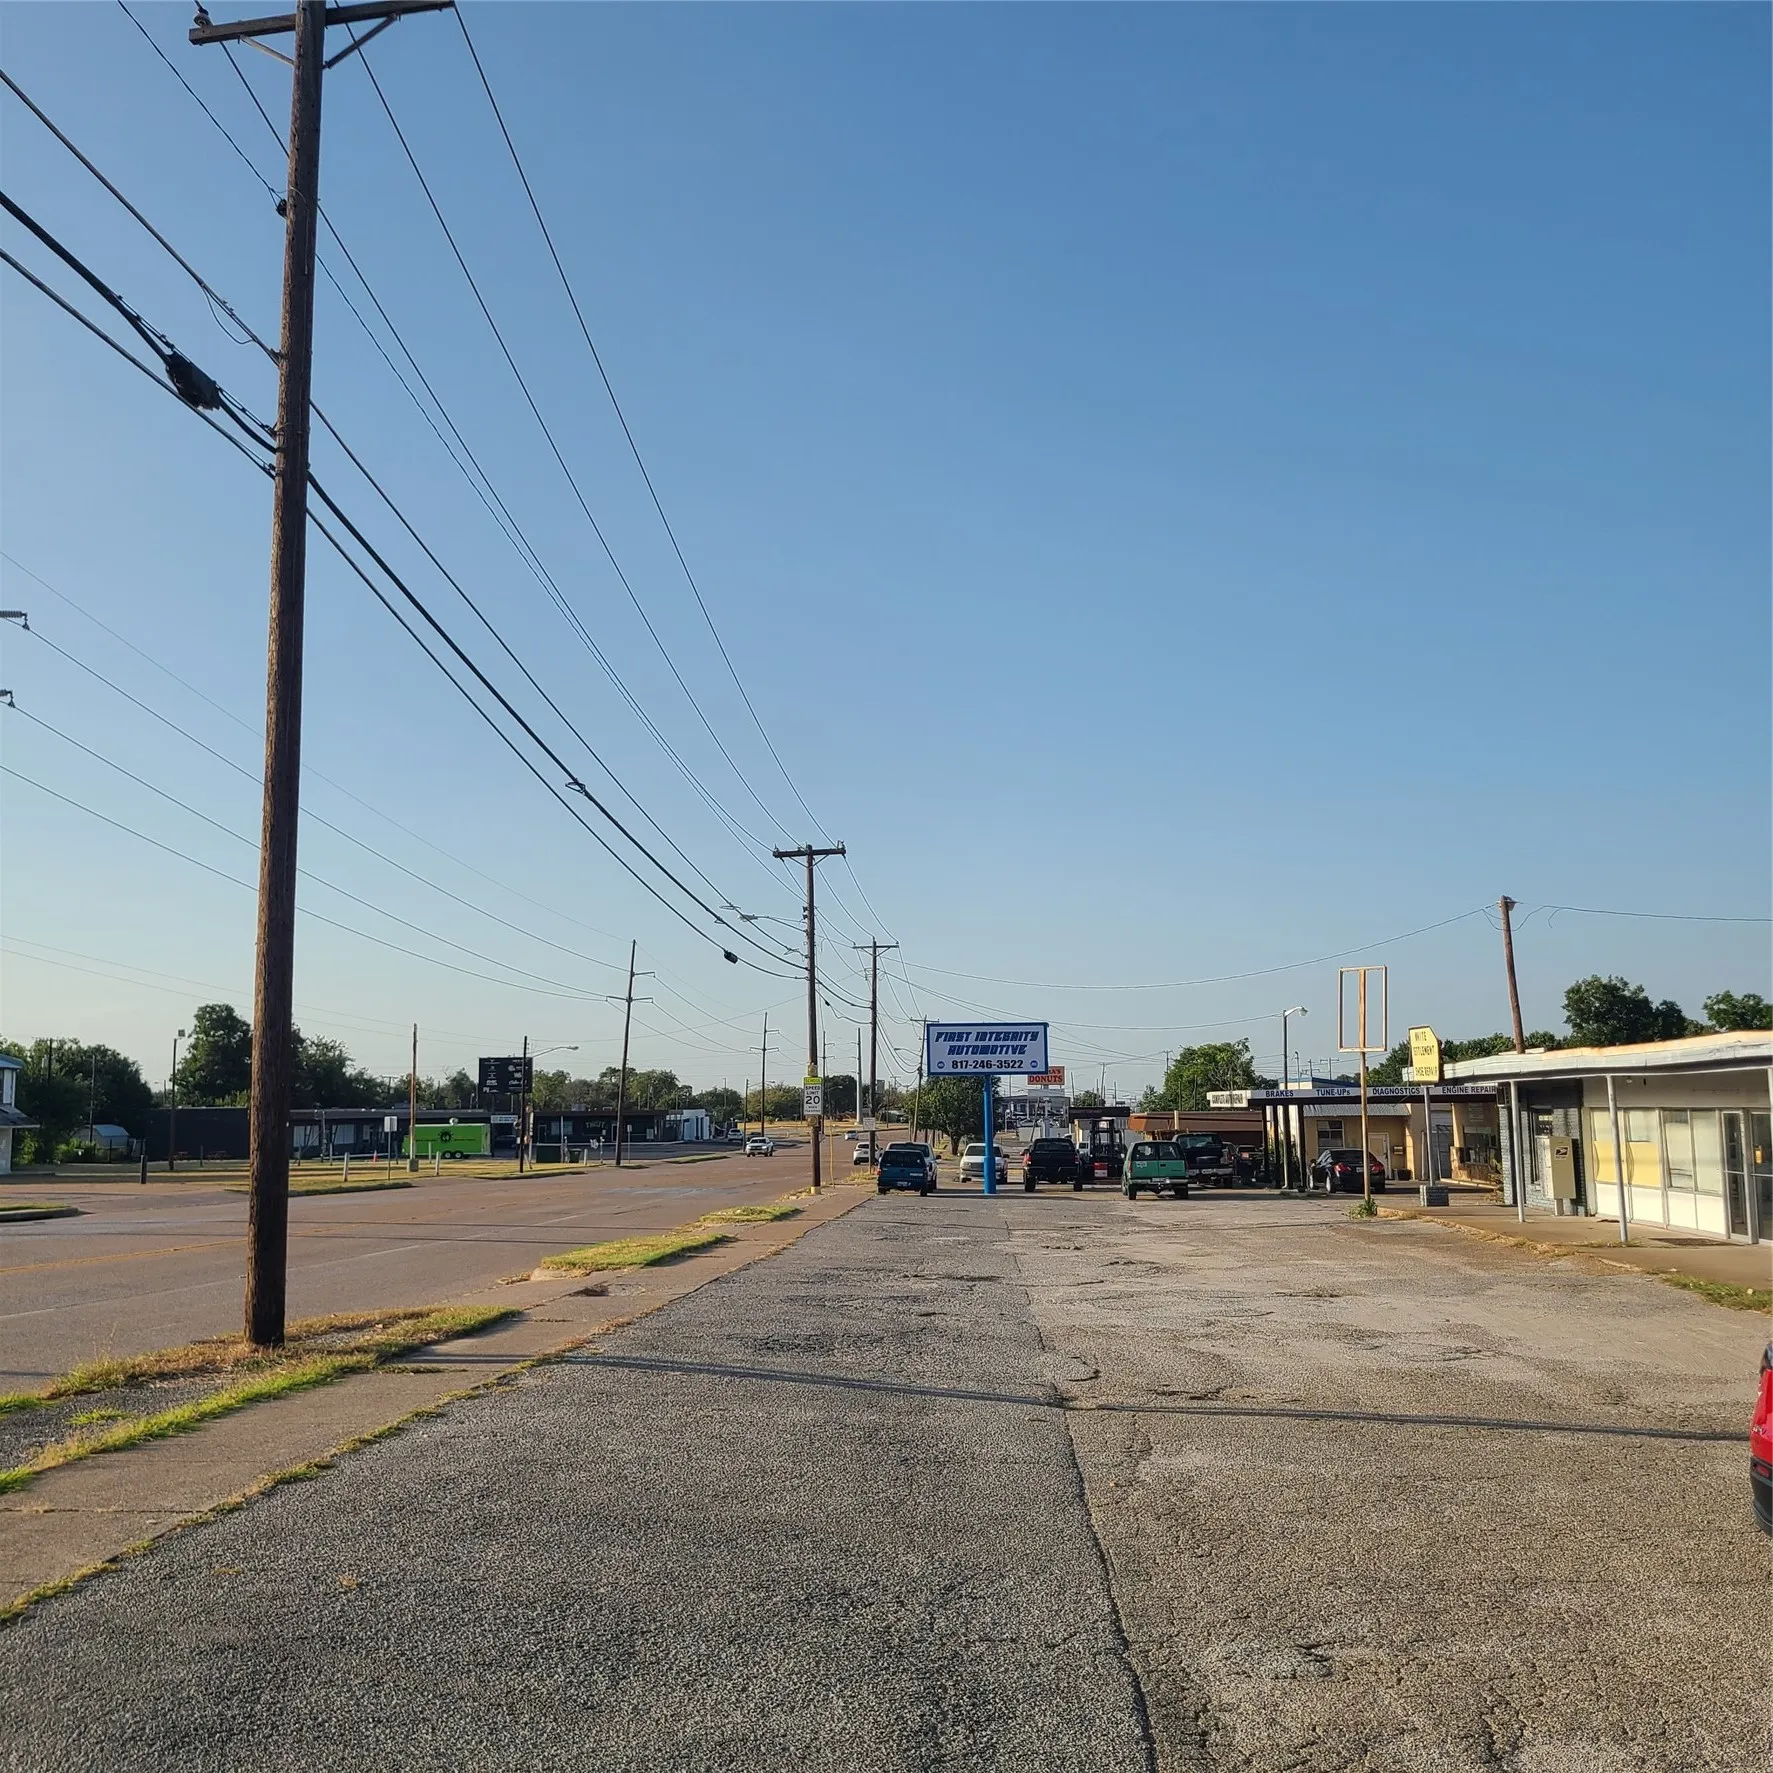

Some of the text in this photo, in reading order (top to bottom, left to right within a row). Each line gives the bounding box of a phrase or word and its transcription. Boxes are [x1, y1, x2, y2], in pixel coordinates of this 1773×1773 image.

[935, 1031, 1039, 1042] FIRST INTEGRITY
[947, 1044, 1027, 1055] AUTOMOTIVE
[951, 1059, 1024, 1069] 817-246-3522
[1029, 1075, 1063, 1083] DONUTS
[1265, 1085, 1496, 1098] BRAKES TUNE-UPs DIAGNOSTICS ENGINE REPAIR
[805, 1095, 821, 1104] 20
